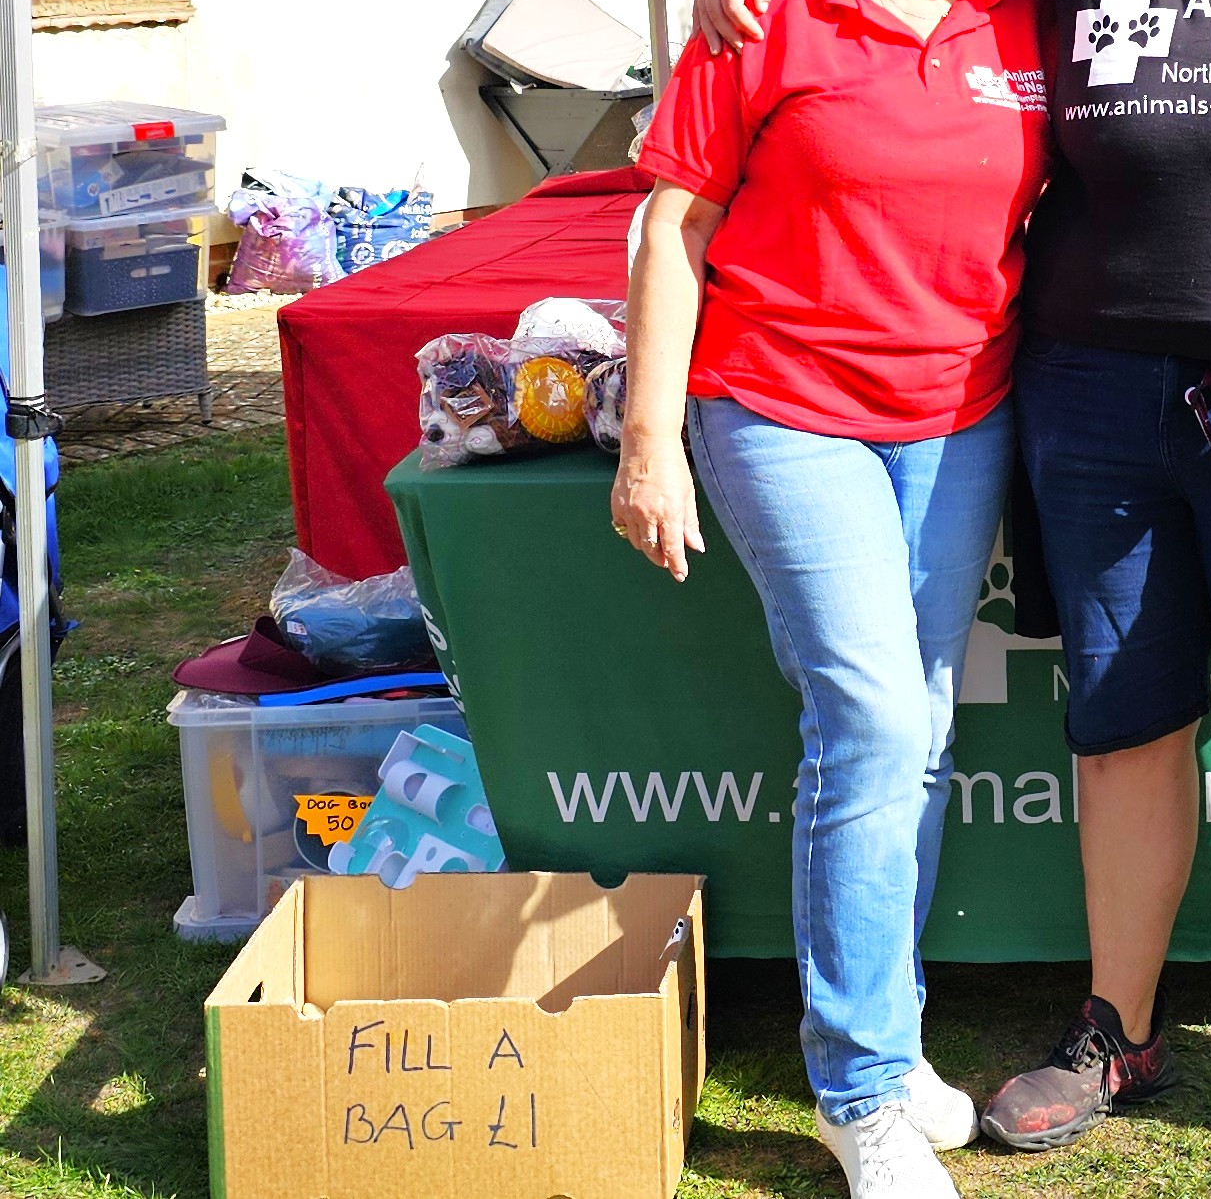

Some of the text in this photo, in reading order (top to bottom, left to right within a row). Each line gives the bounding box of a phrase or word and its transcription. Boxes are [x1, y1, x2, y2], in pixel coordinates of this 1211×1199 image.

[1003, 69, 1045, 82] Anima
[1024, 81, 1047, 94] Ne
[307, 798, 372, 810] DOG BO
[327, 815, 354, 831] 50
[347, 1020, 524, 1074] FILL A
[344, 1093, 537, 1150] BAG £1
